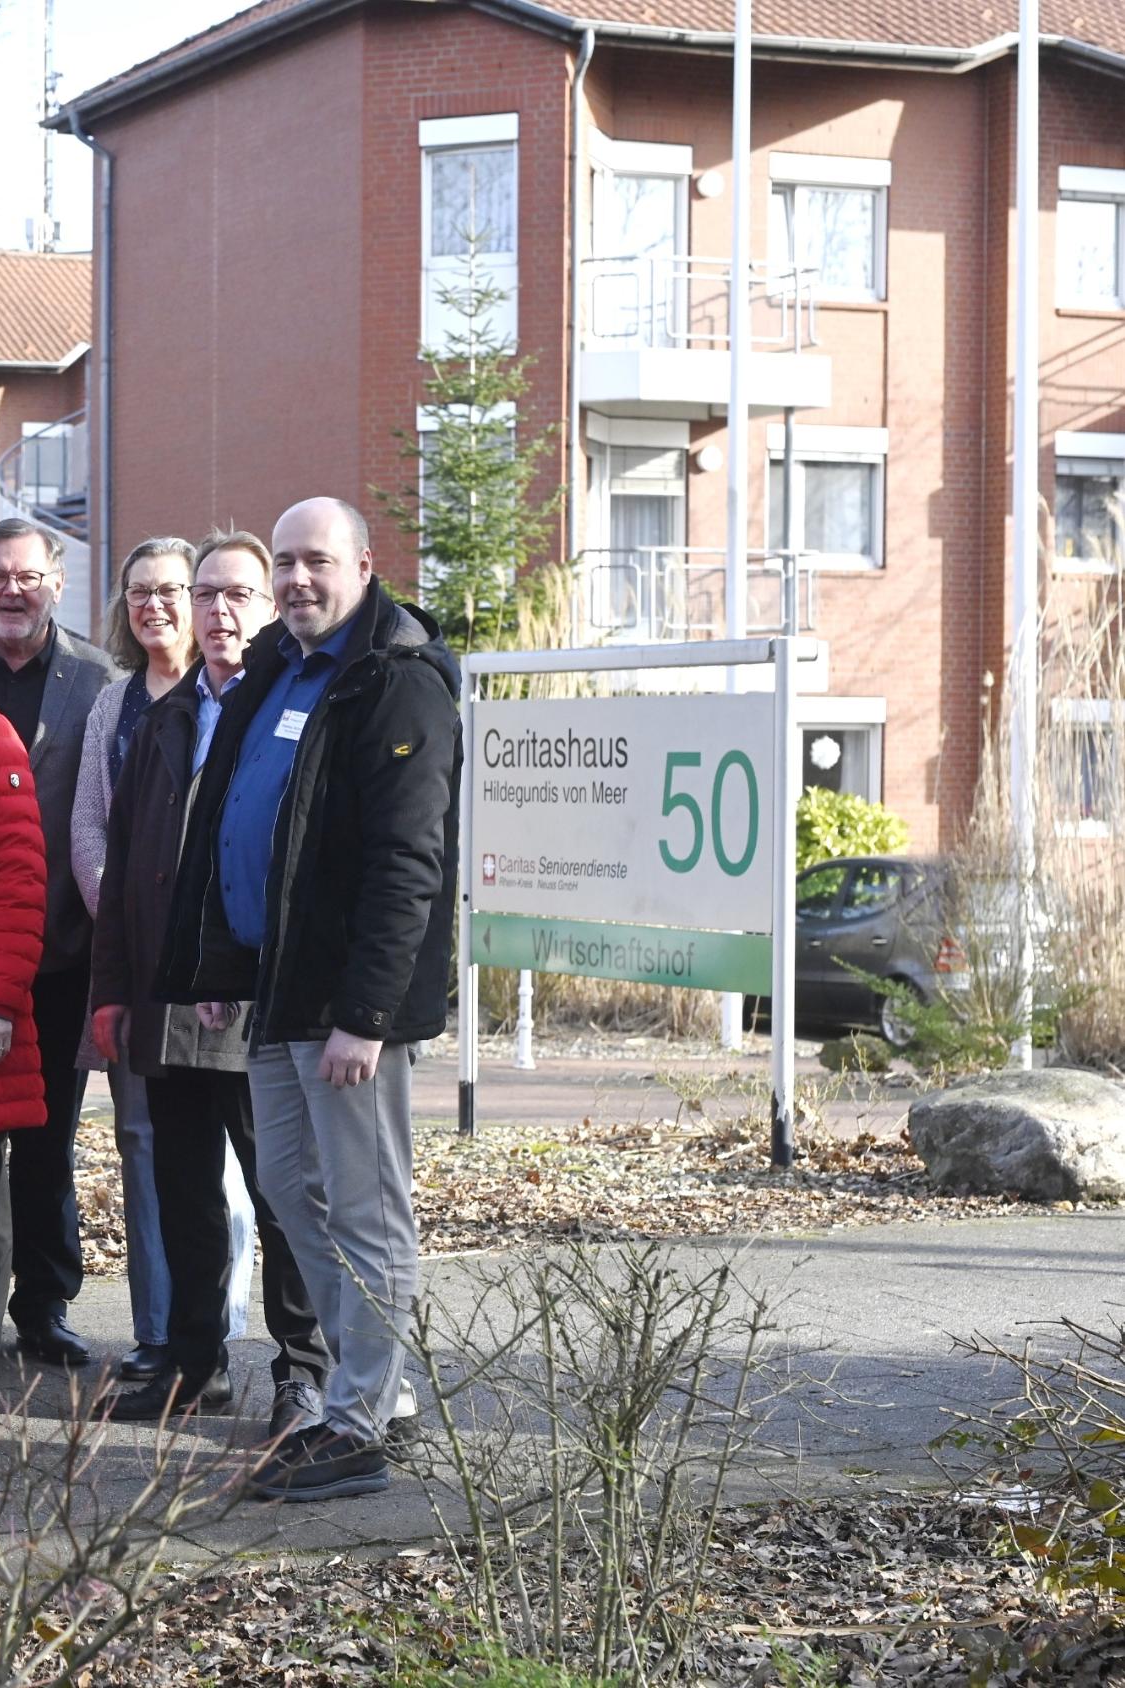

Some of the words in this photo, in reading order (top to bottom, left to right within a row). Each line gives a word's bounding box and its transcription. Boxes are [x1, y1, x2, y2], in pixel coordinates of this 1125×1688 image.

[483, 728, 628, 768] Caritashaus
[483, 780, 559, 808] Hildegundis
[563, 786, 587, 804] von
[592, 781, 628, 804] Meer
[658, 749, 759, 877] 50
[498, 854, 536, 874] Caritas
[538, 855, 628, 880] Seniorendienste
[558, 879, 579, 892] GmbH
[532, 927, 695, 977] Wirtschaftshof
